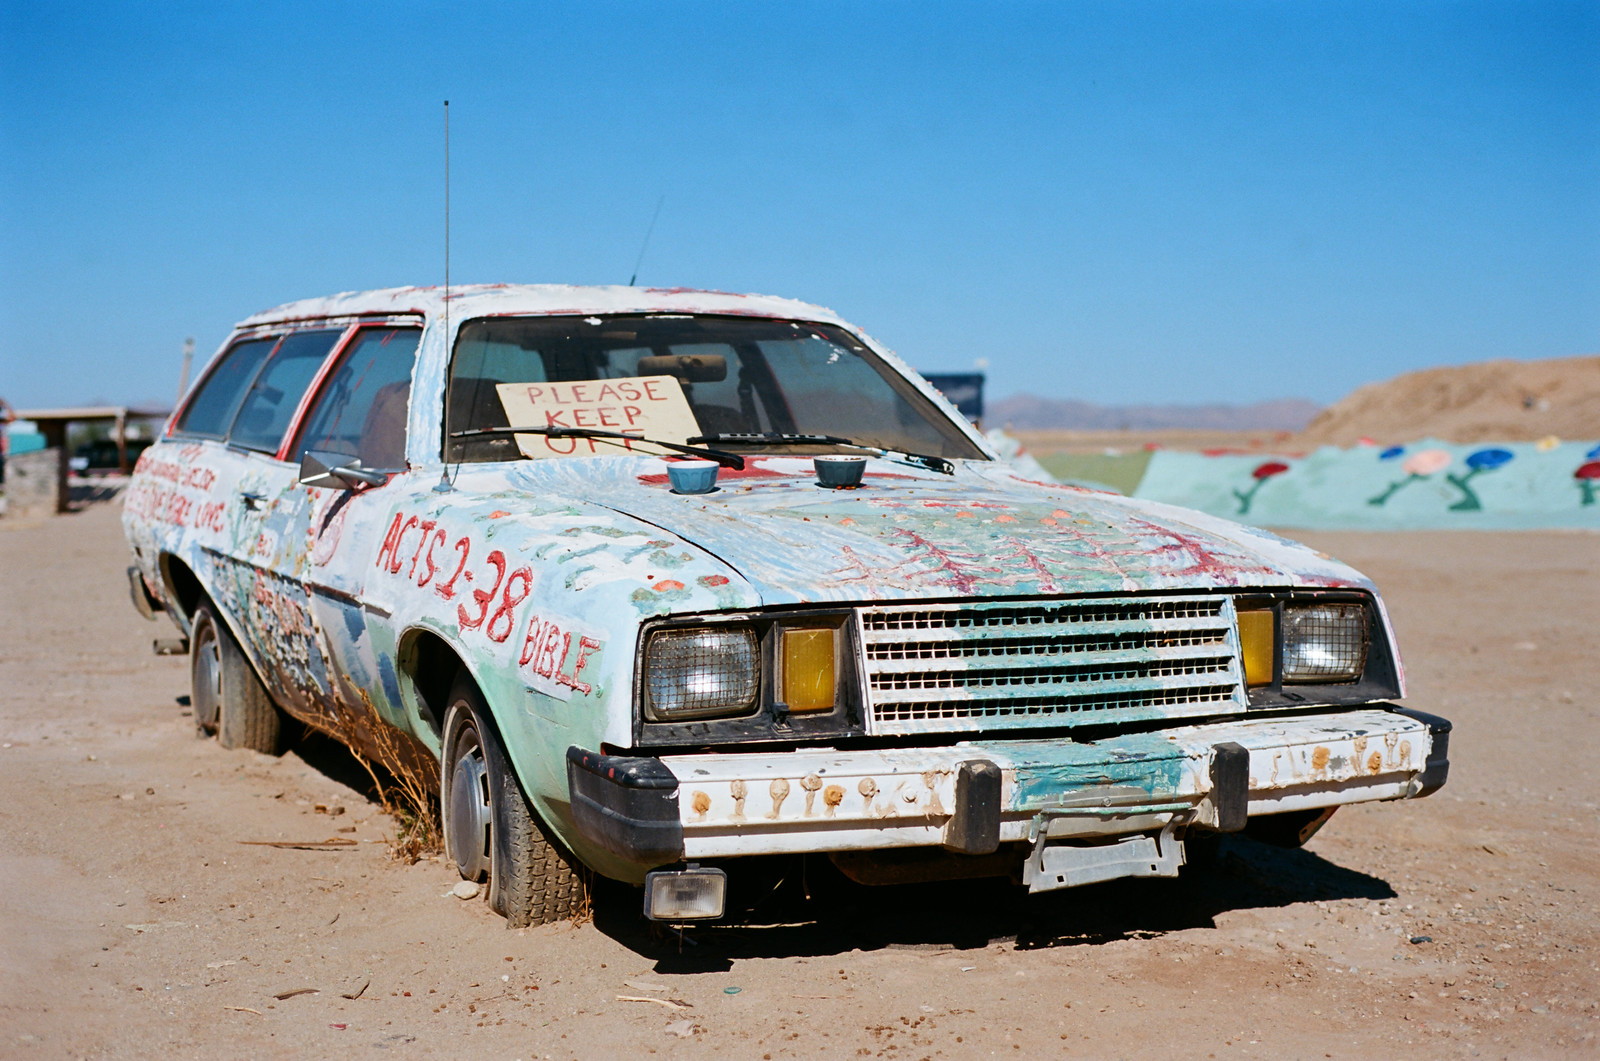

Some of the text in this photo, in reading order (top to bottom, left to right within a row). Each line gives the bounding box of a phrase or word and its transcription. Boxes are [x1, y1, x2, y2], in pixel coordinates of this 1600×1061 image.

[527, 380, 668, 405] PLEASE
[545, 405, 642, 428] KEEP
[376, 512, 447, 588] ACTS
[518, 615, 602, 697] BIBLE
